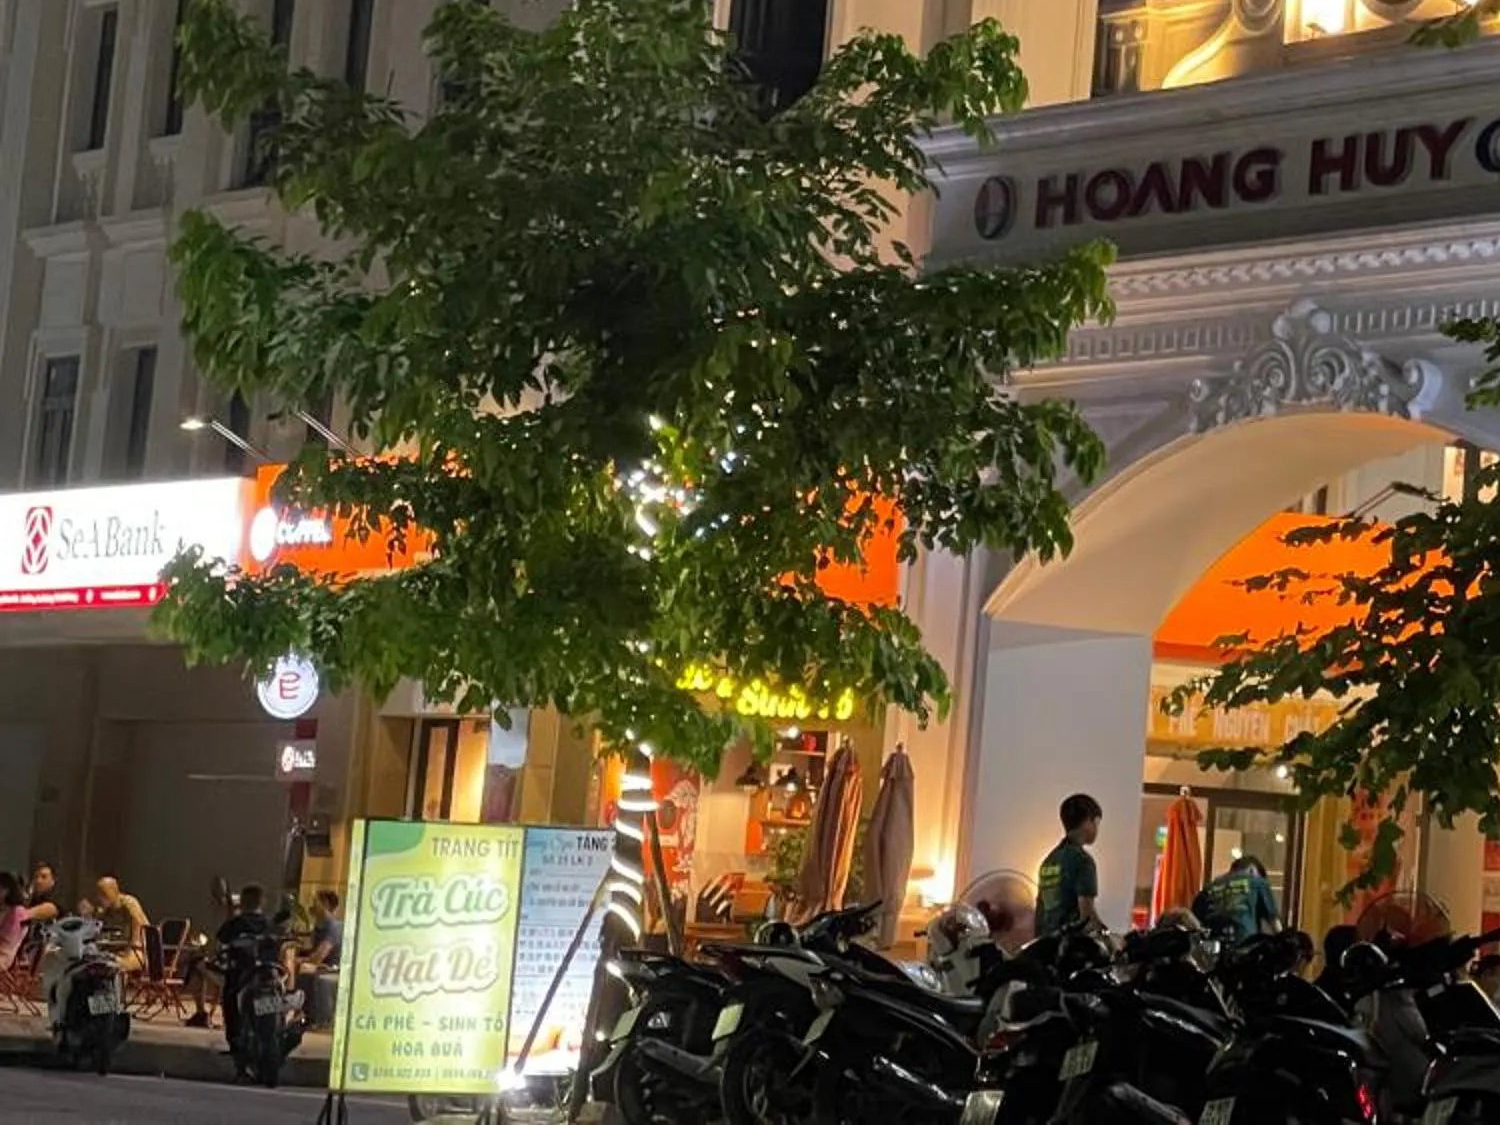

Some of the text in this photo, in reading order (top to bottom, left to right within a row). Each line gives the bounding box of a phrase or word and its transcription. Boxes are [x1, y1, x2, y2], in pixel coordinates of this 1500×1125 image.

[1308, 116, 1469, 197] HUY
[57, 510, 167, 561] SeABank
[432, 835, 491, 858] TRANG
[377, 880, 436, 919] Trà
[443, 877, 504, 915] Cúc
[376, 947, 440, 991] Hạt
[383, 1010, 416, 1031] PHÊ
[437, 1014, 477, 1032] SINH
[390, 1040, 425, 1057] HOA
